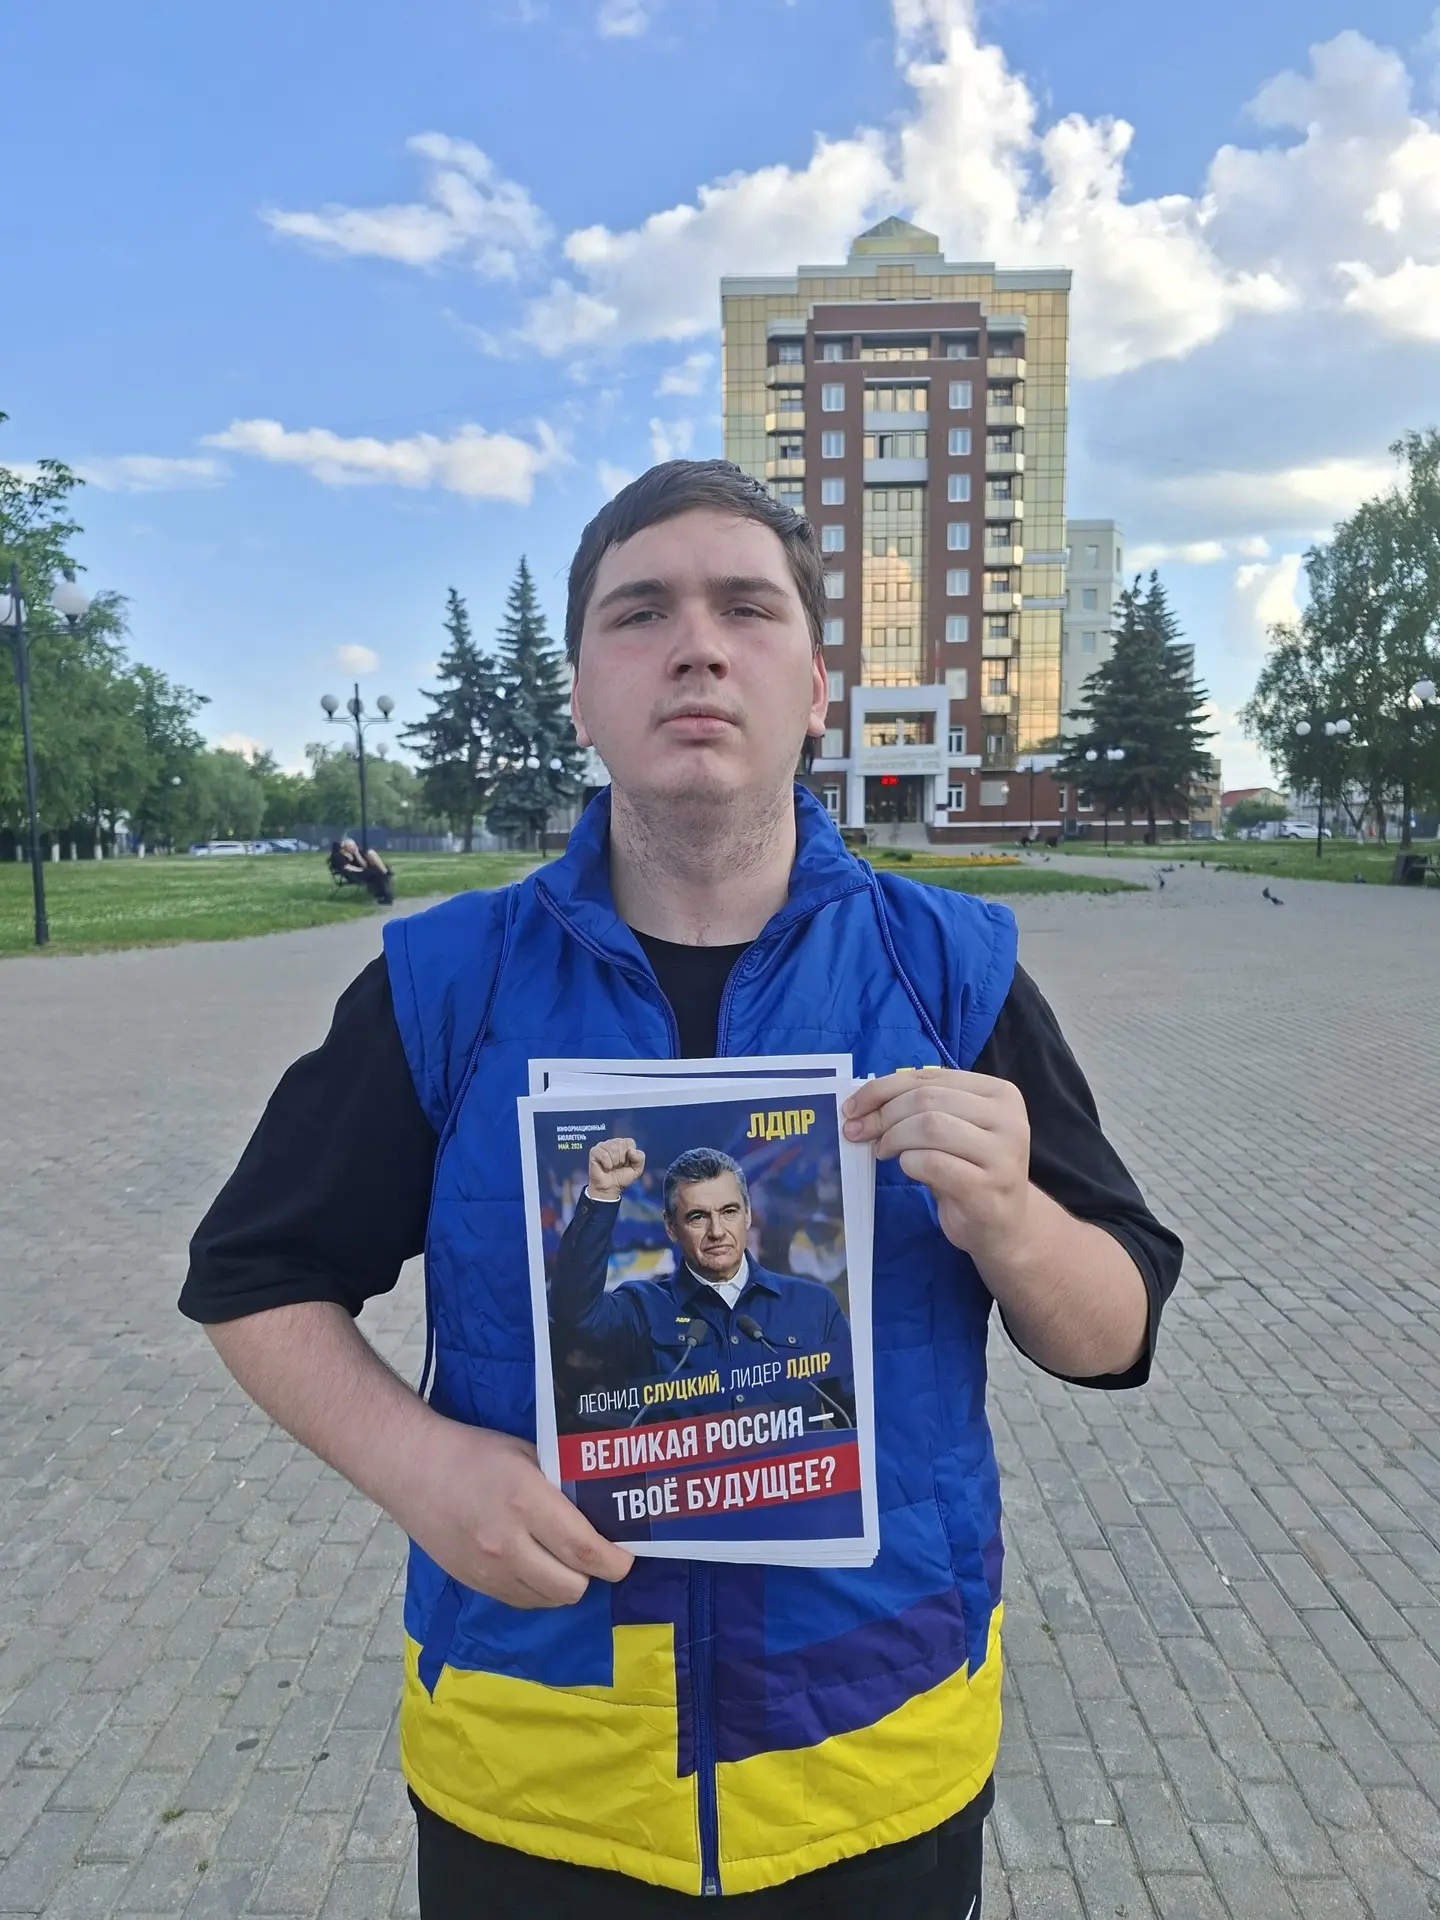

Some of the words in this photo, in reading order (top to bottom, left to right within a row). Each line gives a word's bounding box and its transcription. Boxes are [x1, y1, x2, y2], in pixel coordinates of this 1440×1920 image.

[556, 1122, 607, 1133] ИНФОРМАЦИОННЫЙ
[557, 1133, 588, 1142] БЮЛЛЕТЕНЬ
[746, 1109, 816, 1141] ЛДПР
[579, 1387, 640, 1414] ЛЕОНИД
[643, 1369, 726, 1405] СЛУЦКИЙ,
[730, 1361, 782, 1390] ЛИДЕР
[786, 1352, 831, 1380] ЛДПР
[581, 1425, 698, 1473] ВЕЛИКАЯ
[705, 1406, 804, 1453] РОССИЯ
[612, 1477, 680, 1522] ТВОЁ
[686, 1455, 837, 1511] БУДУЩЕЕ?
